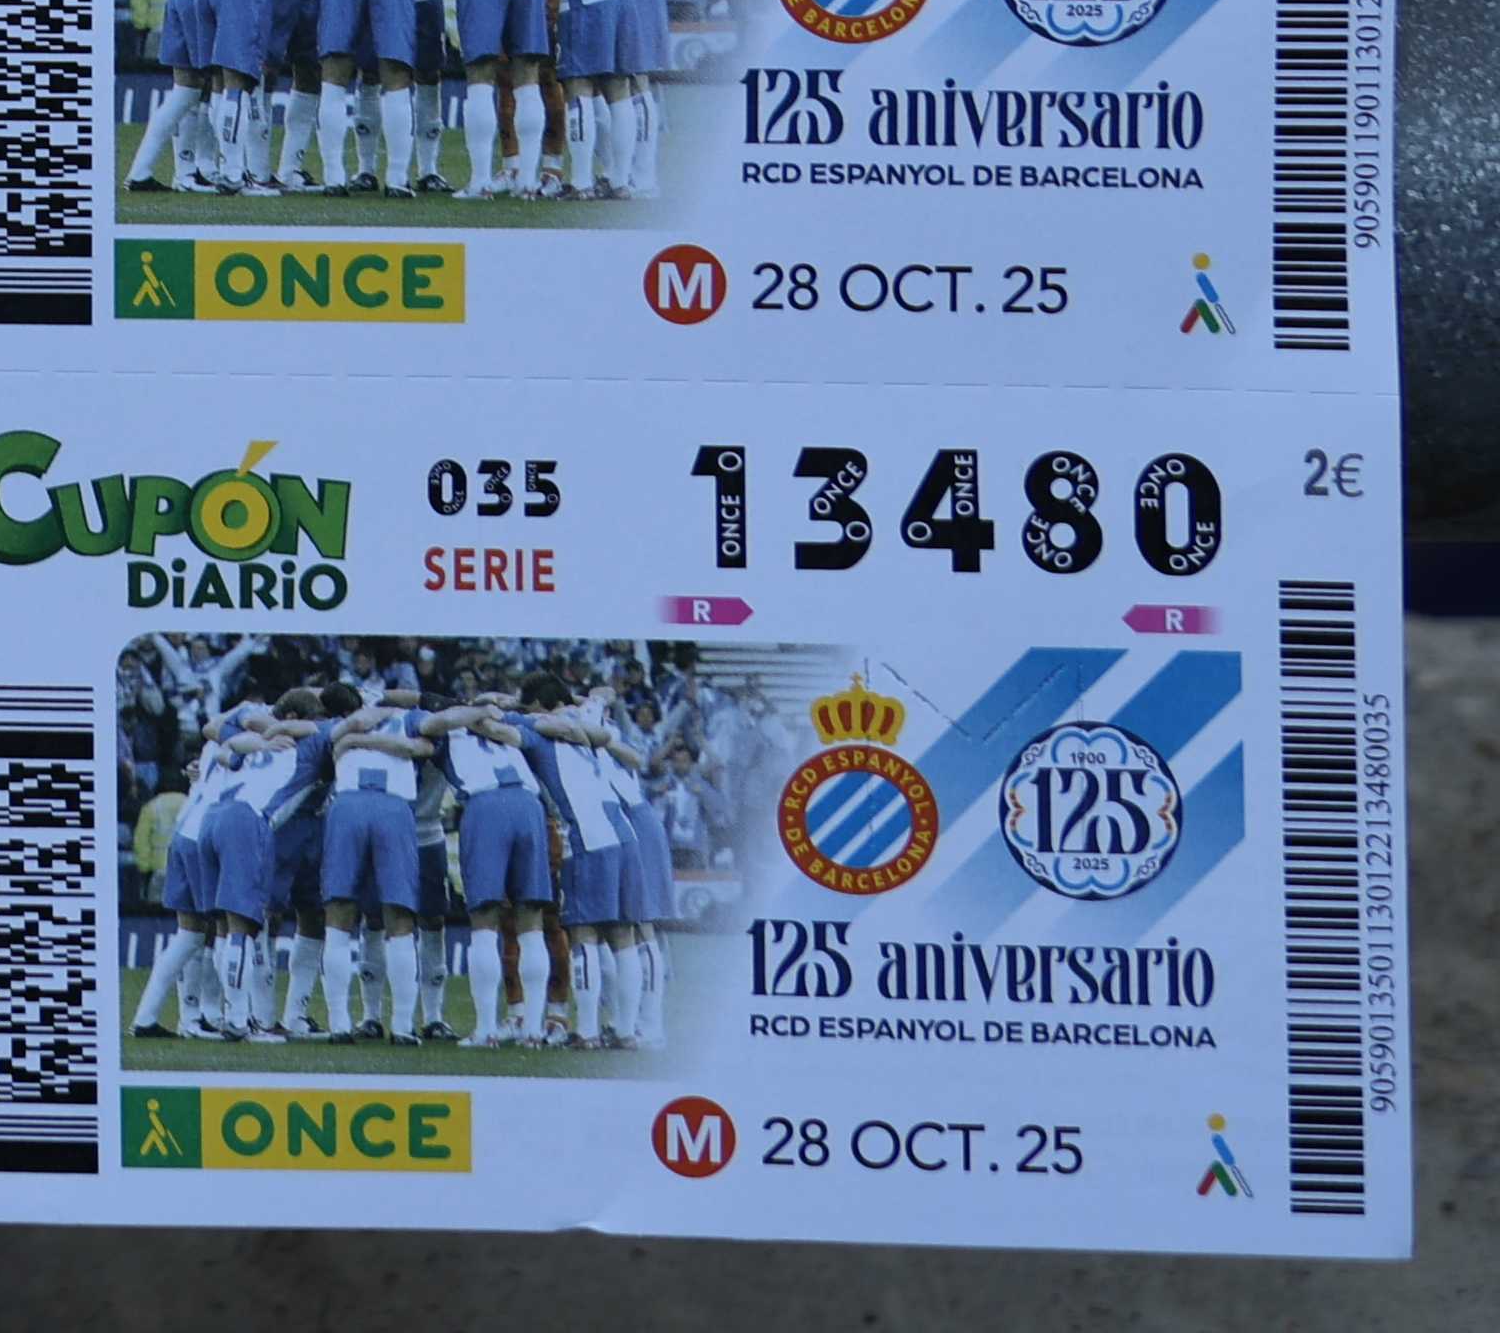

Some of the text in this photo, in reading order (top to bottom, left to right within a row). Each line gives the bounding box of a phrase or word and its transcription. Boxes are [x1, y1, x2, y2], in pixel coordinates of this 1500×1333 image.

[1066, 4, 1103, 17] 2025
[739, 68, 1204, 150] 125 aniversario
[742, 162, 1204, 189] RCD ESPANYOL DE BARCELONA
[213, 252, 446, 311] ONCE
[658, 261, 713, 310] M
[752, 262, 1068, 315] 28 OCT. 25
[427, 459, 561, 518] 035
[1304, 449, 1363, 498] 2€
[690, 445, 1222, 577] 13480
[425, 547, 557, 593] SERIE
[1363, 694, 1394, 1112] 905901350113012213480035
[746, 919, 1215, 1008] 125 aniversario
[750, 1014, 1217, 1048] RCD ESPANYOL DE BARCELONA
[220, 1098, 453, 1163] ONCE
[666, 1113, 722, 1164] M
[762, 1117, 1083, 1175] 28 OCT. 25
